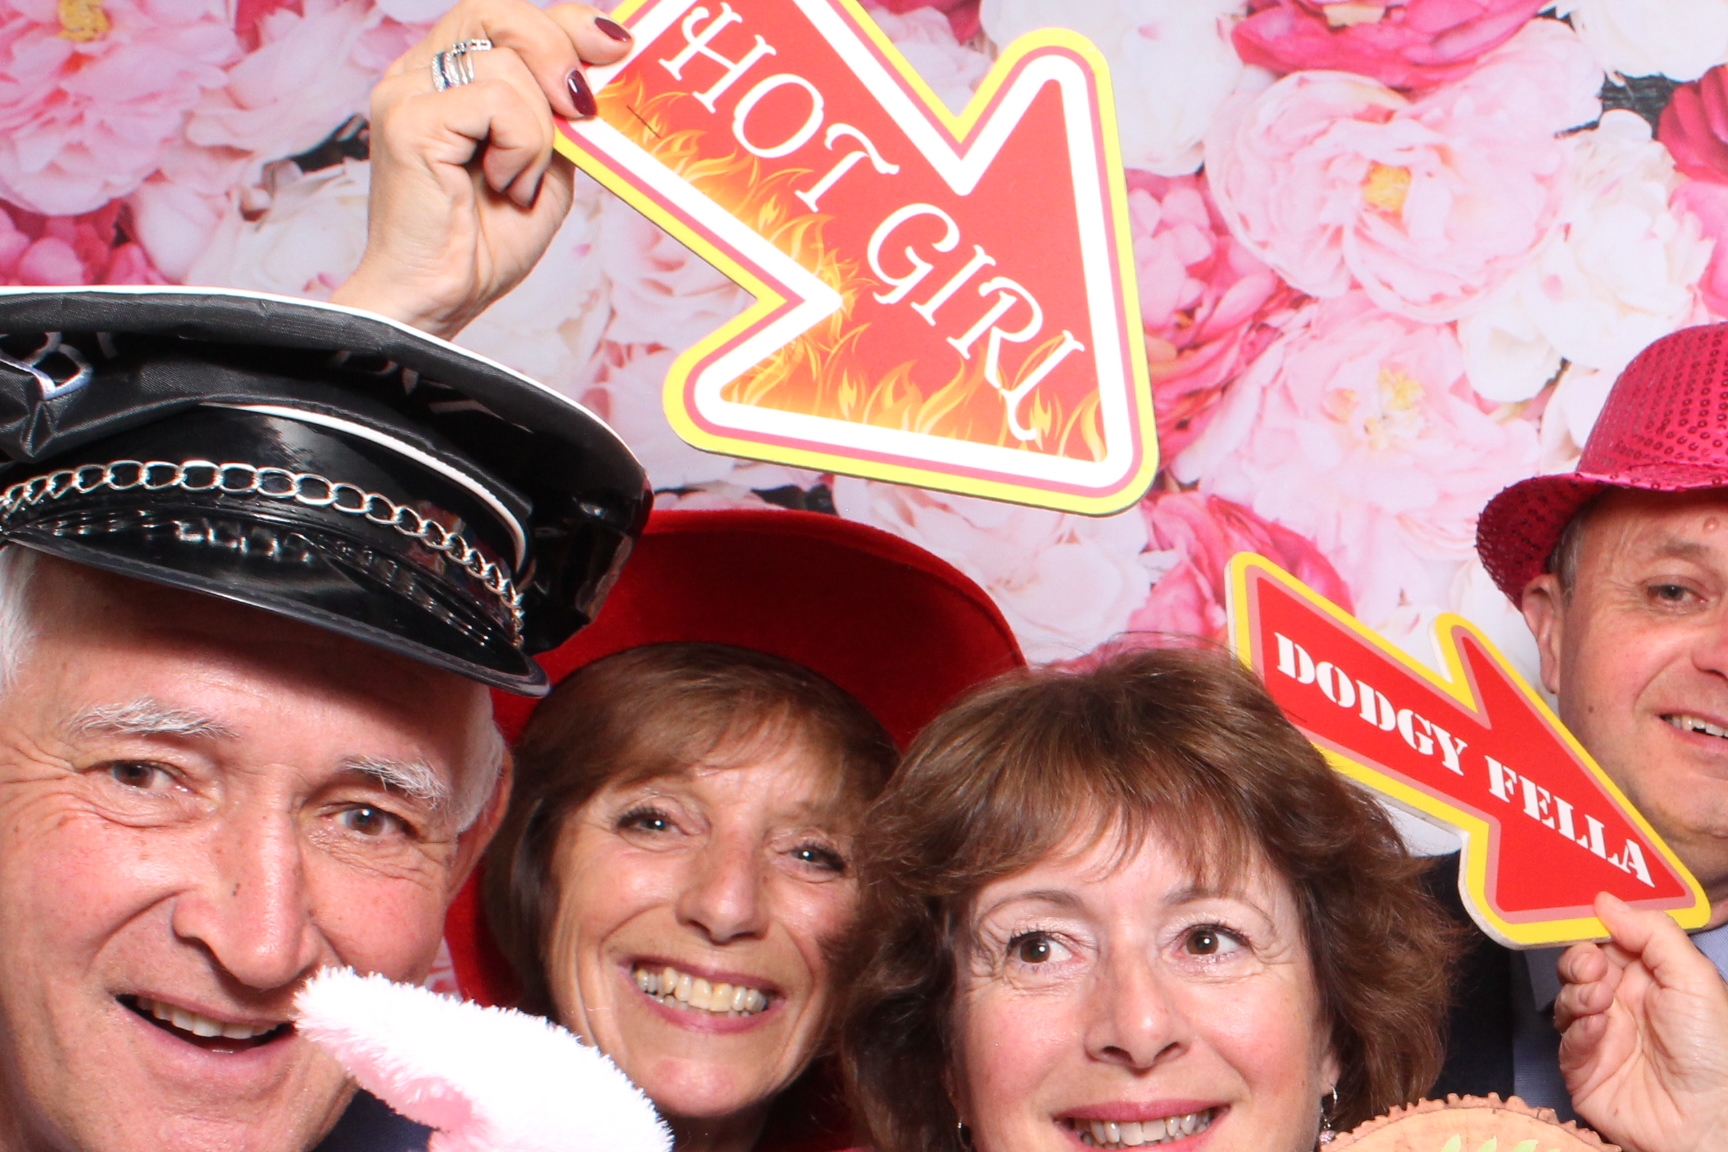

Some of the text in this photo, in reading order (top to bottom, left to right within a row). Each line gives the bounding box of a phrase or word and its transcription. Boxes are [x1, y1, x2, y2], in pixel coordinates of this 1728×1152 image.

[658, 1, 1085, 442] HOT GIRL
[1275, 632, 1656, 888] DODGY FELLA
